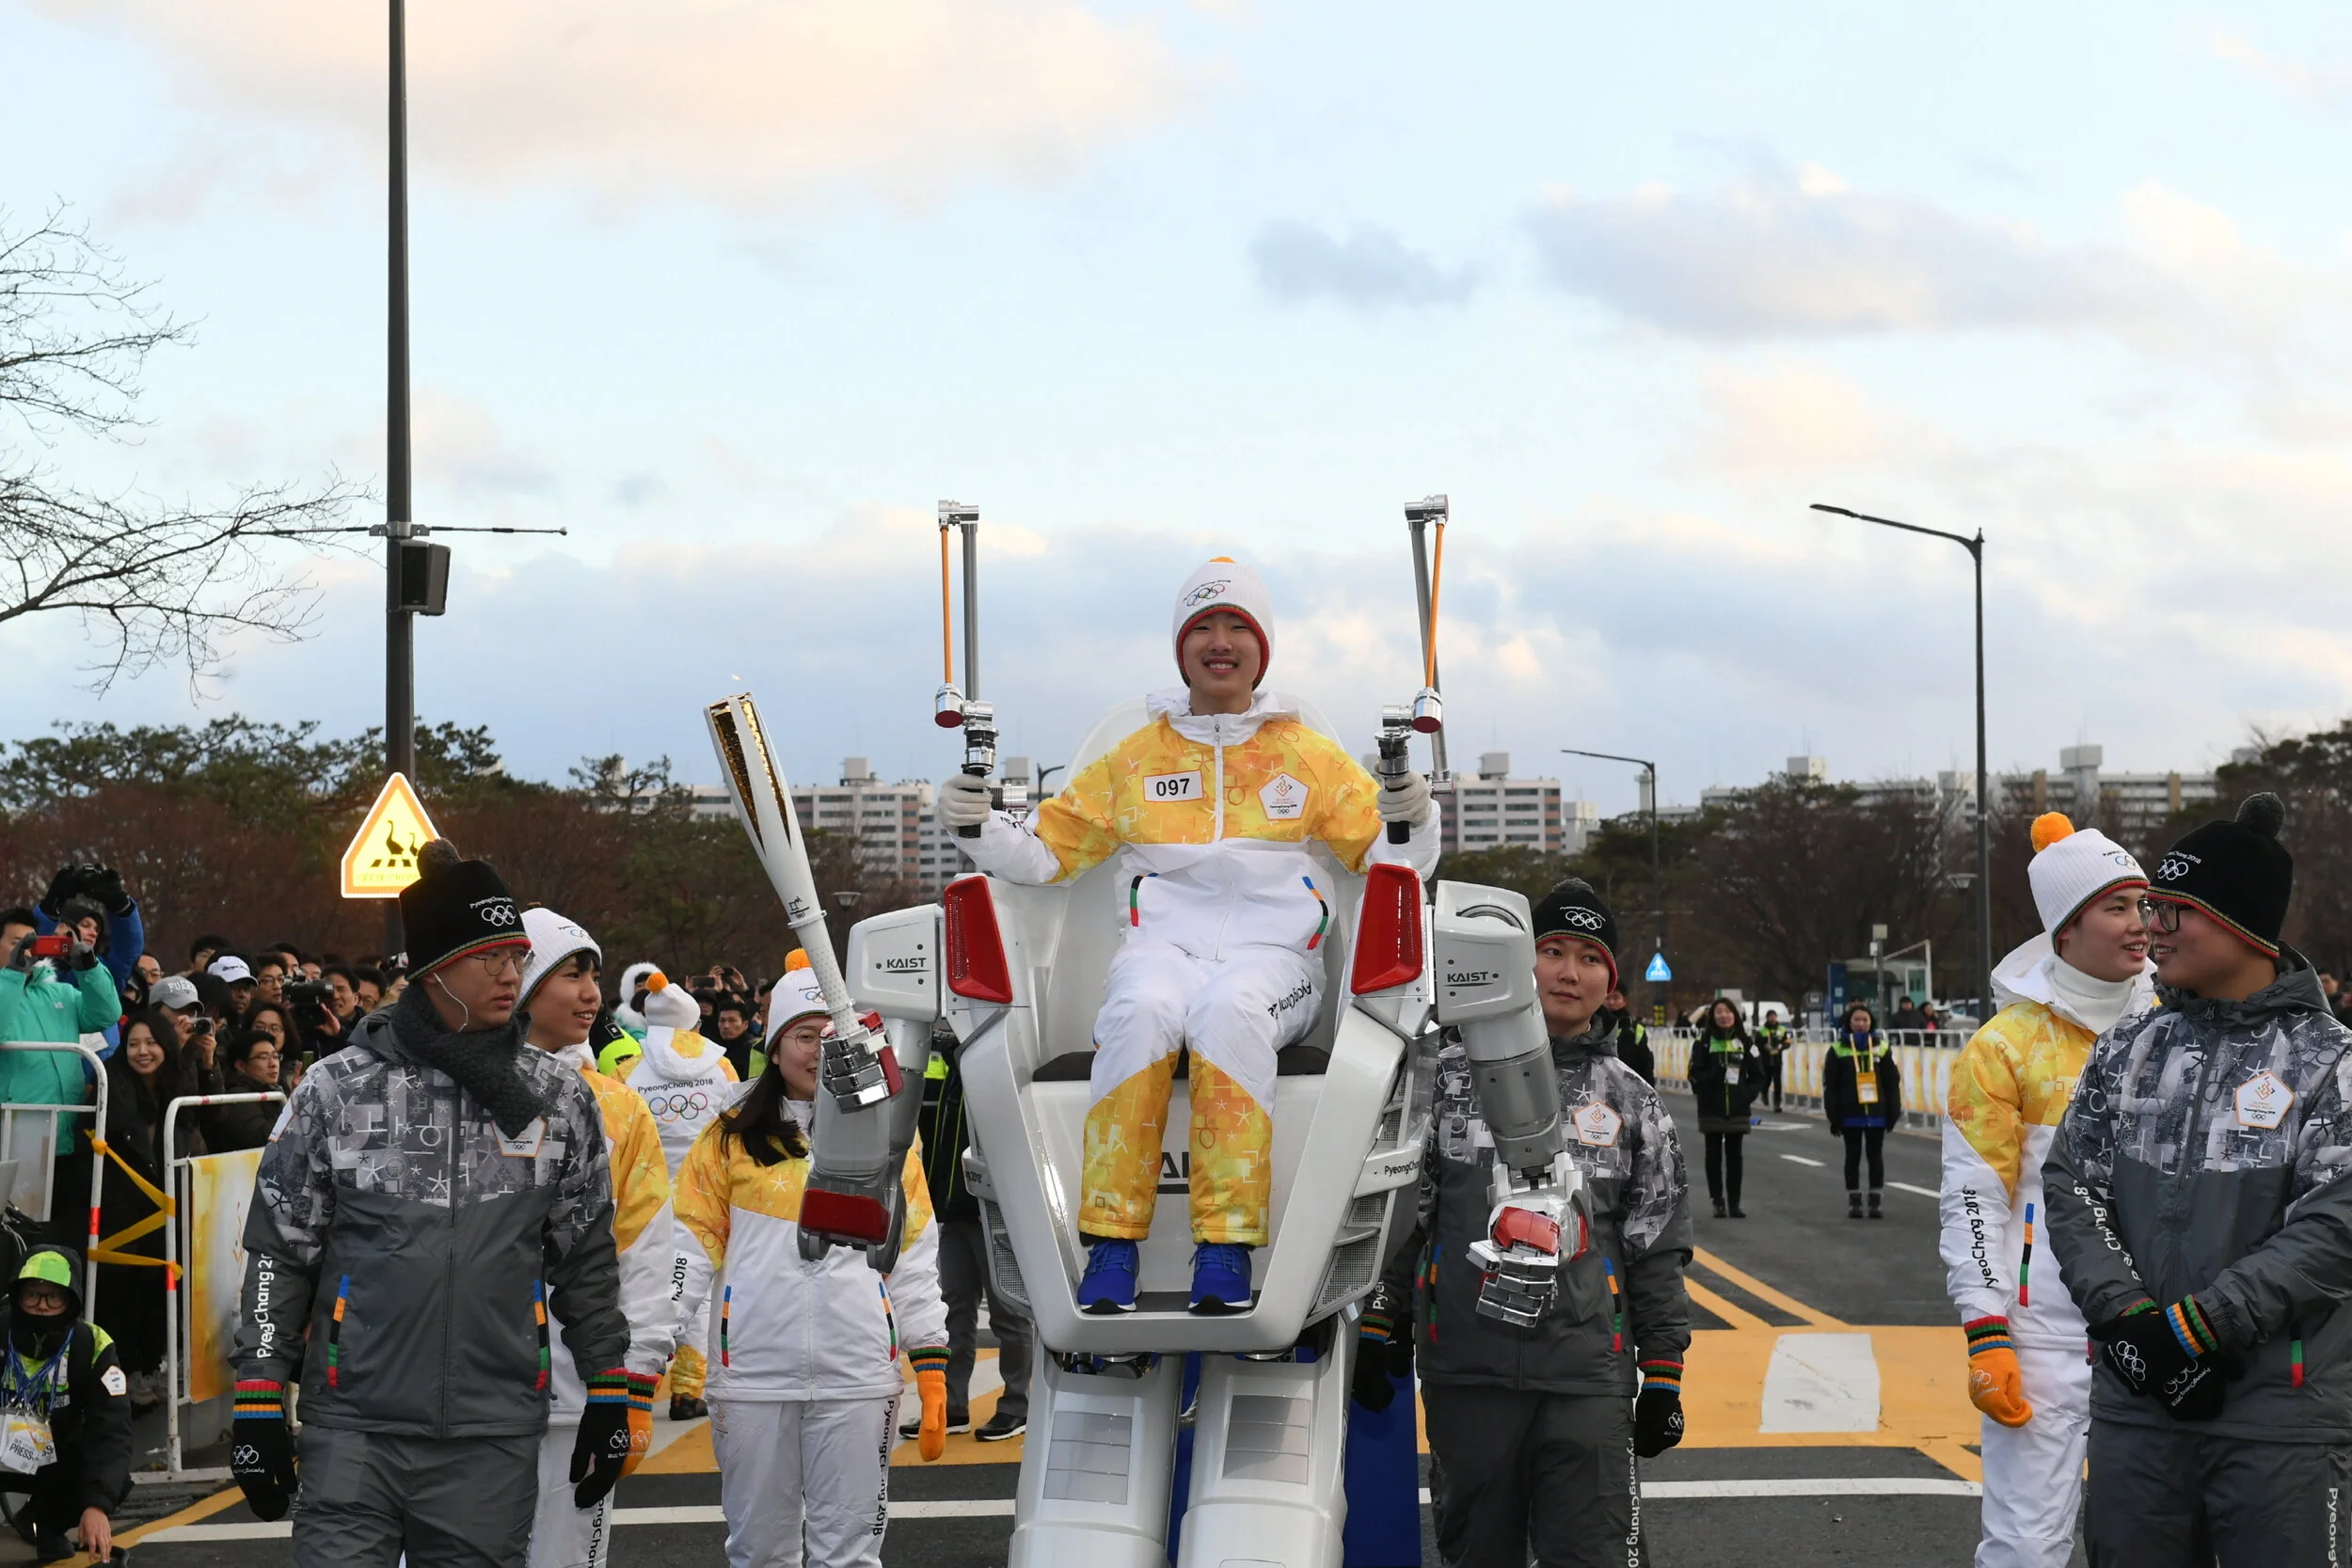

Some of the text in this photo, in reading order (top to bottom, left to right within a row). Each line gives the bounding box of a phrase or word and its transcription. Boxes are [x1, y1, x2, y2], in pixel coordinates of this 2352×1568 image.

[1156, 778, 1189, 797] 097
[886, 958, 927, 969] KAIST
[1447, 972, 1488, 982] KAIST
[637, 1078, 713, 1095] PyeongChang 2018
[1963, 1189, 1980, 1216] 2018
[672, 1258, 688, 1289] 2018
[9, 1443, 35, 1461] PRESS
[873, 1505, 887, 1536] 2018
